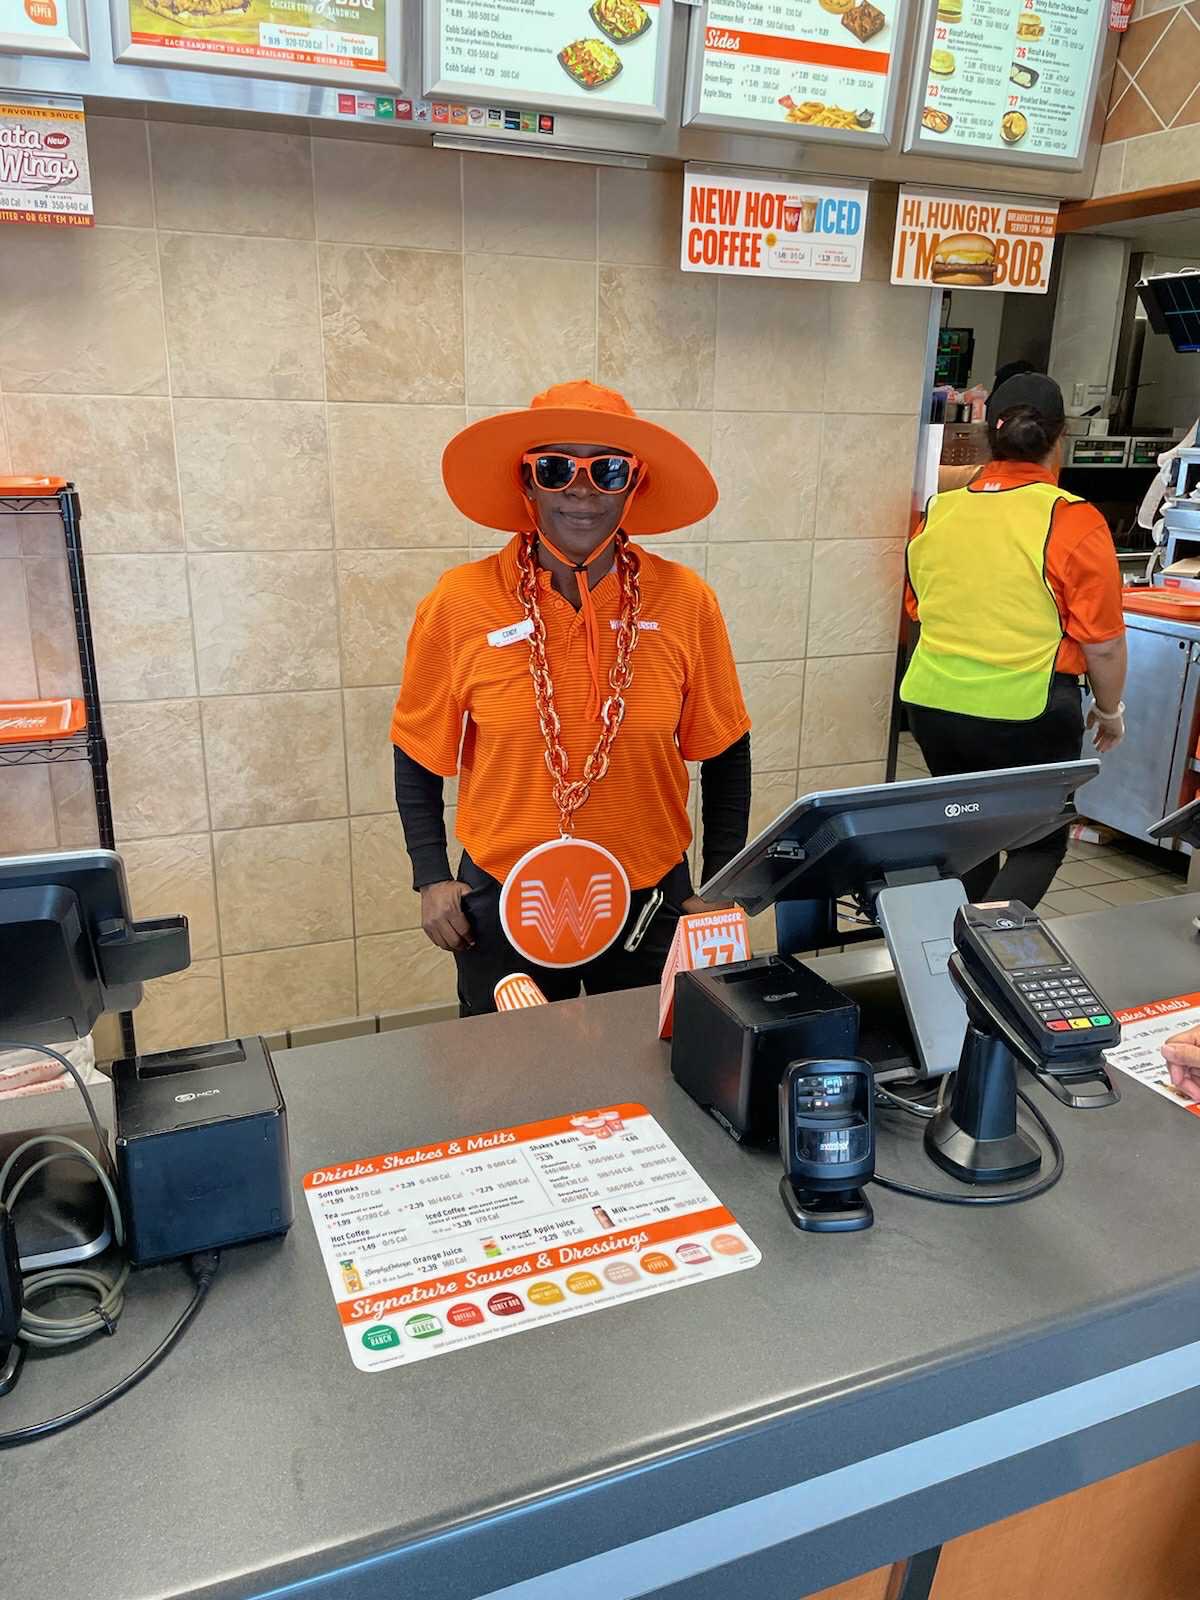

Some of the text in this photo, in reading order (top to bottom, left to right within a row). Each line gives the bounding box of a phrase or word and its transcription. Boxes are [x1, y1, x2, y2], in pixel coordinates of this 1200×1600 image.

[461, 26, 476, 36] Salad
[491, 30, 512, 40] Chicken
[705, 29, 740, 50] Sides
[461, 64, 475, 74] Salad
[2, 107, 80, 120] FAVORITE SAUCE
[46, 136, 68, 144] New!
[0, 149, 79, 186] Wings
[690, 186, 740, 227] NEW
[745, 191, 787, 230] HOT
[815, 198, 861, 235] ICED
[902, 199, 1000, 233] HI, HUNGRY.
[26, 213, 90, 225] OR GET 'EM PLAIN
[688, 228, 762, 268] COFFEE
[896, 231, 1046, 287] I'M BOB.
[961, 803, 980, 813] NCR
[687, 912, 743, 929] WHATABURGER
[703, 944, 734, 967] 77
[312, 1132, 516, 1185] Drinks, Shakes & Malts
[318, 1184, 360, 1199] Soft Drinks
[325, 1212, 338, 1220] Tea
[425, 1211, 442, 1221] Iced
[443, 1206, 466, 1216] Coffee
[611, 1205, 628, 1215] Milk
[533, 1224, 555, 1235] Apple
[555, 1218, 575, 1228] Juice
[331, 1229, 370, 1243] Hot Coffee
[396, 1235, 409, 1243] Cal
[412, 1252, 442, 1264] Orange
[442, 1246, 463, 1257] Juice
[455, 1255, 468, 1264] Cal
[351, 1231, 649, 1321] Signature Sauces & Dressings
[369, 1334, 393, 1347] RANCH
